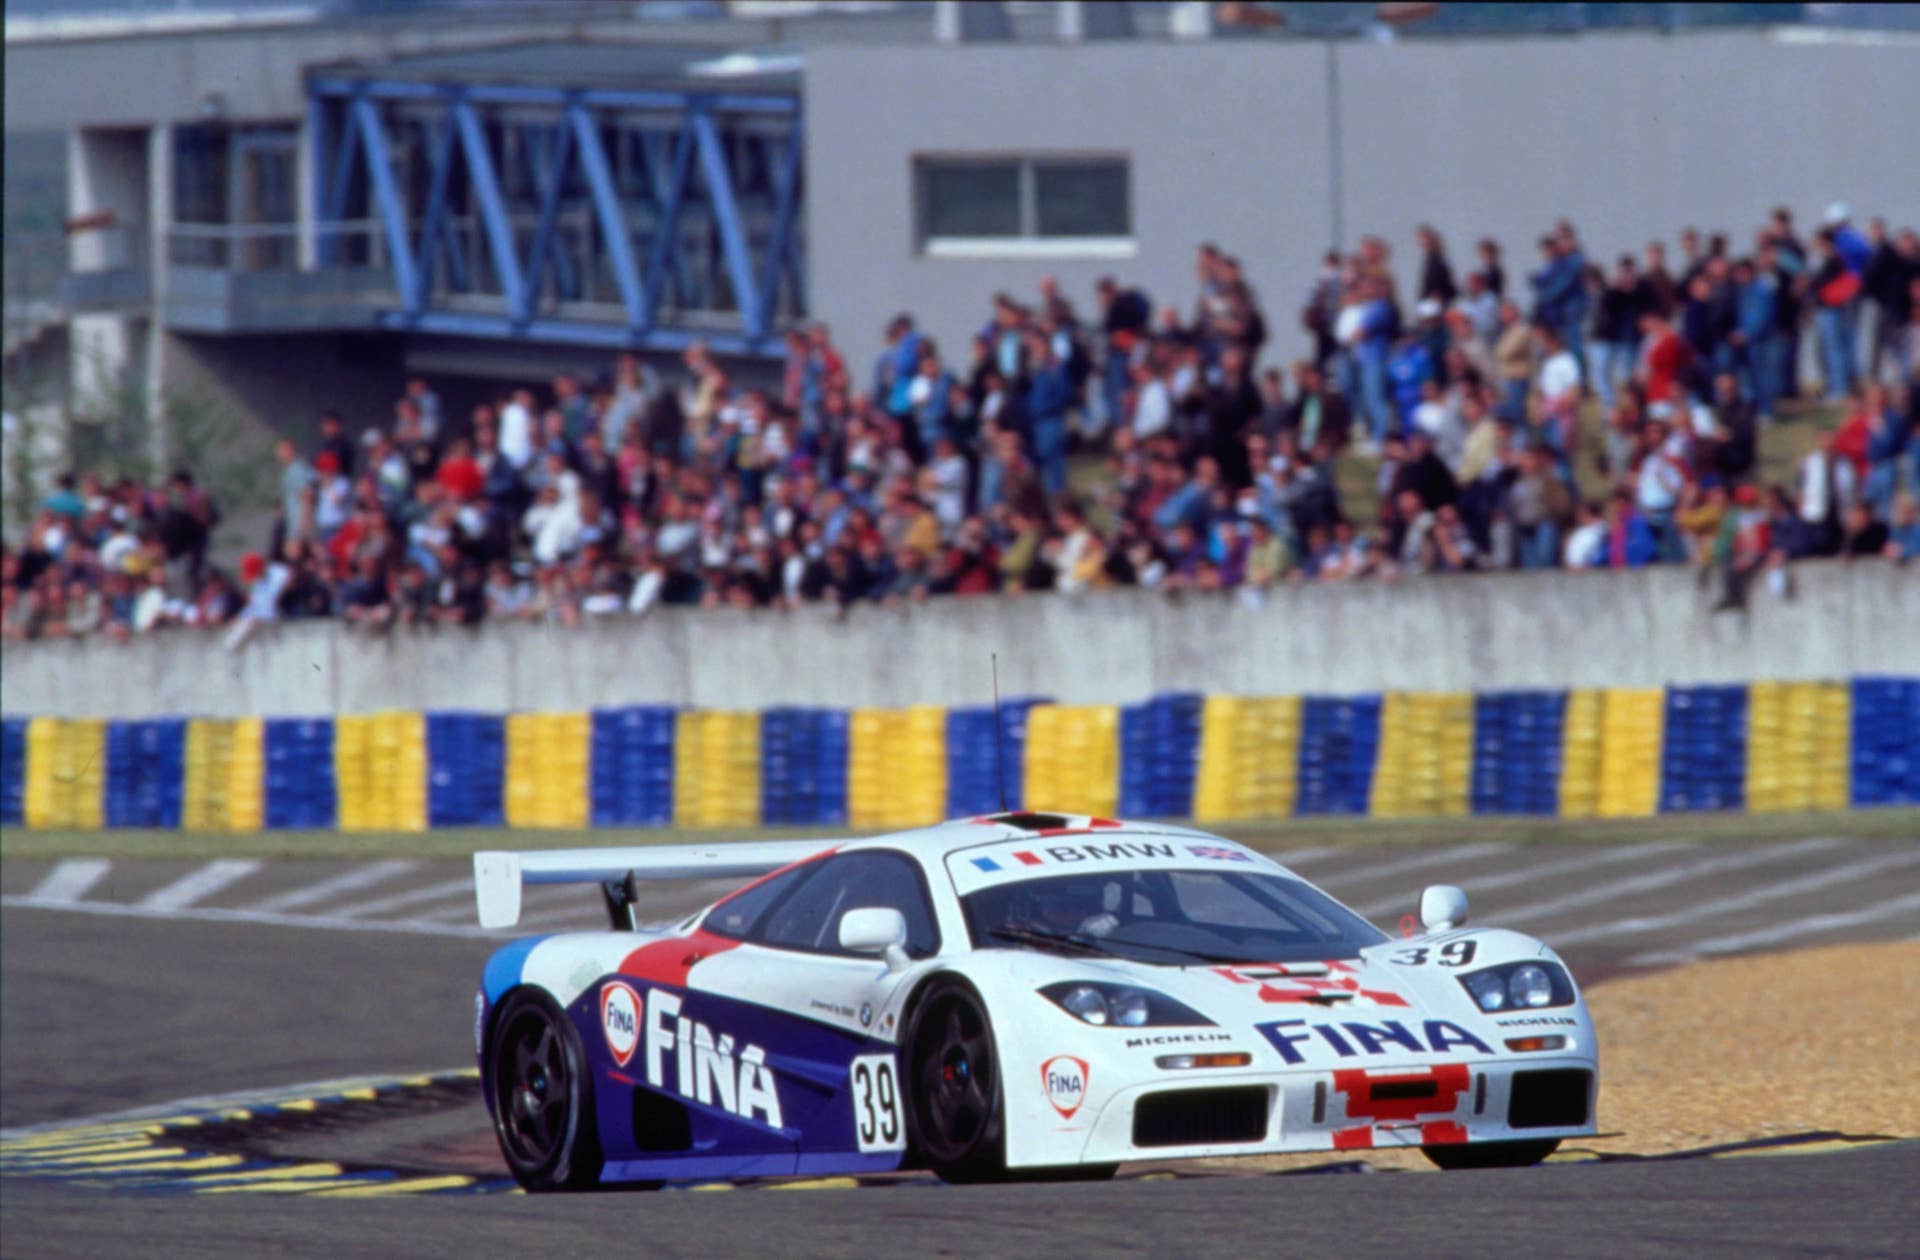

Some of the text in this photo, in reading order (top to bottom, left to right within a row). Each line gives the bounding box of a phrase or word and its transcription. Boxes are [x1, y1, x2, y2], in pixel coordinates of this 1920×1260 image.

[1044, 843, 1176, 863] BMW
[1389, 939, 1477, 967] 39
[607, 1001, 634, 1035] FINA
[1497, 1016, 1576, 1028] MICHELIN
[1126, 1033, 1232, 1048] MICHELIN
[1254, 1019, 1495, 1065] FINA
[646, 987, 783, 1129] FINA
[1048, 1071, 1082, 1093] FINA
[854, 1062, 899, 1145] 39
